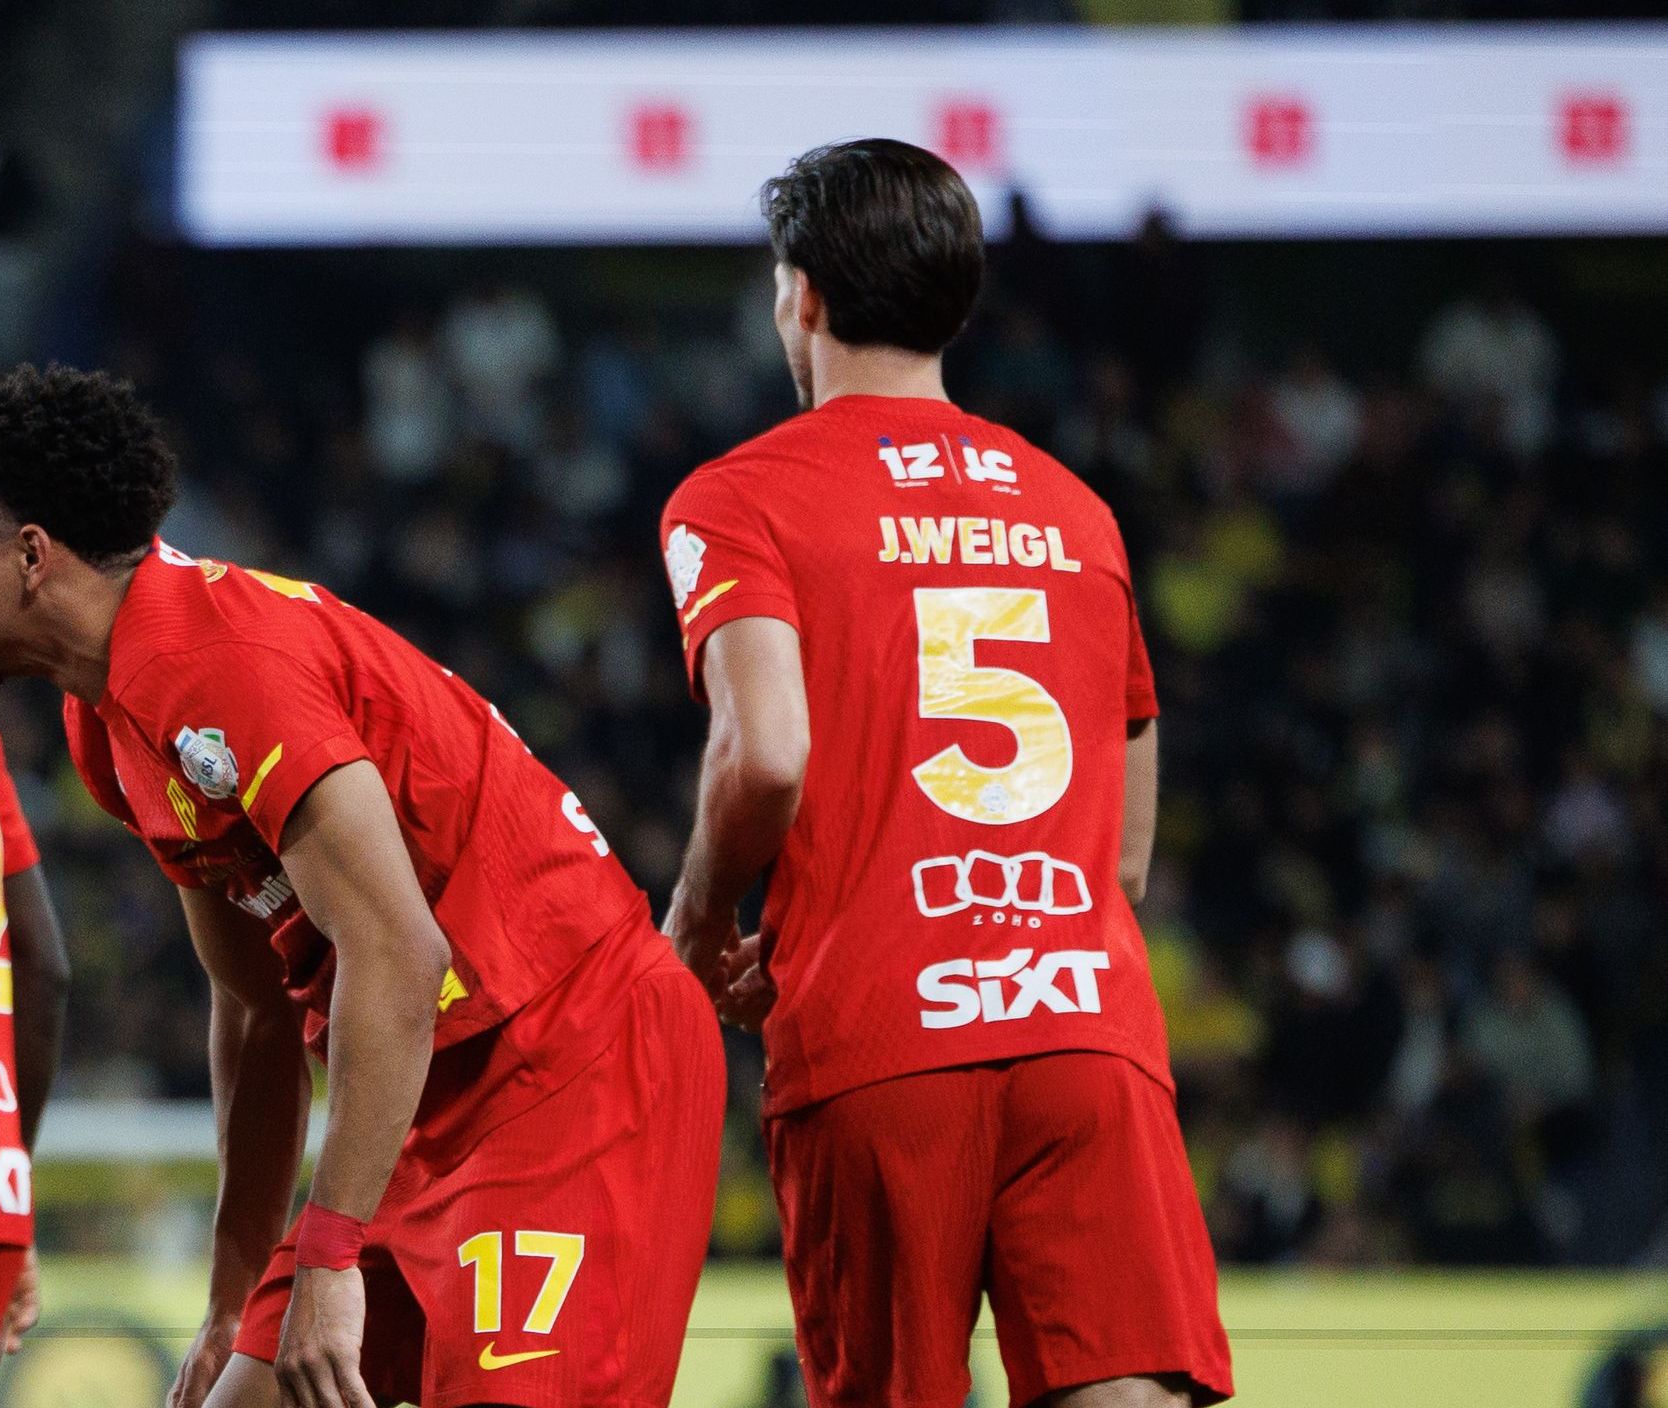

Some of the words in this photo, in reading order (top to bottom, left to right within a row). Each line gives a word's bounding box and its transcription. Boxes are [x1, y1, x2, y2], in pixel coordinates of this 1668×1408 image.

[878, 516, 1082, 573] J.WEIGL
[911, 586, 1073, 825] 5
[972, 911, 1042, 930] ZOHO
[458, 1230, 585, 1335] 17
